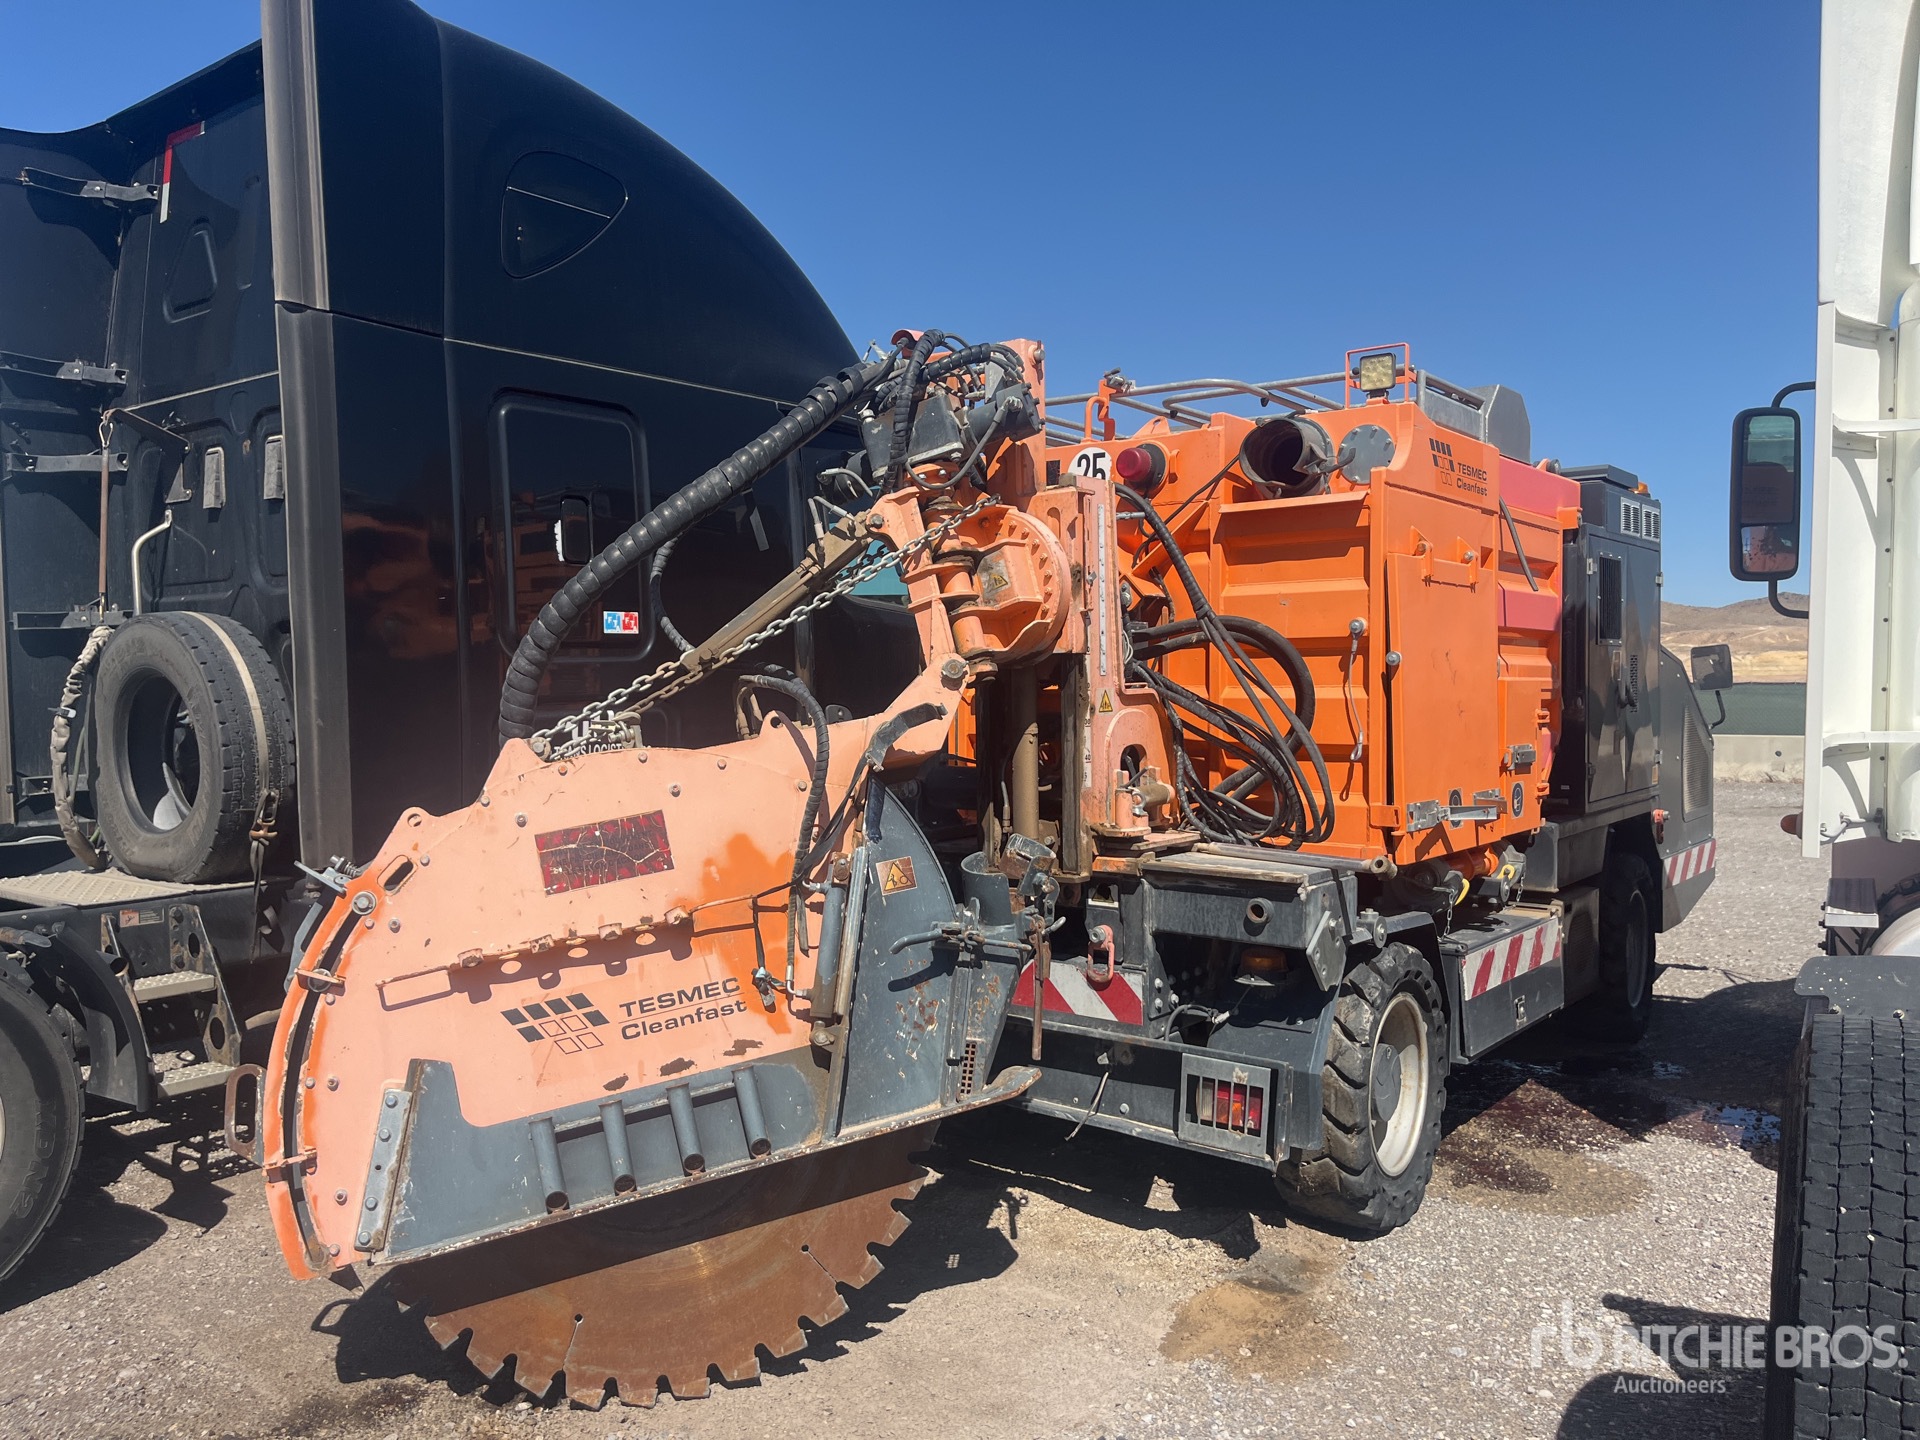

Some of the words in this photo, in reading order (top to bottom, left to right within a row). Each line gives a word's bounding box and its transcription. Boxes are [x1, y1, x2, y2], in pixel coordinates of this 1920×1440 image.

[1077, 452, 1106, 480] 25
[1457, 462, 1487, 481] TESMEC
[1456, 477, 1488, 496] Cleanfast
[619, 977, 741, 1018] TESMEC
[621, 1000, 748, 1040] Cleanfast
